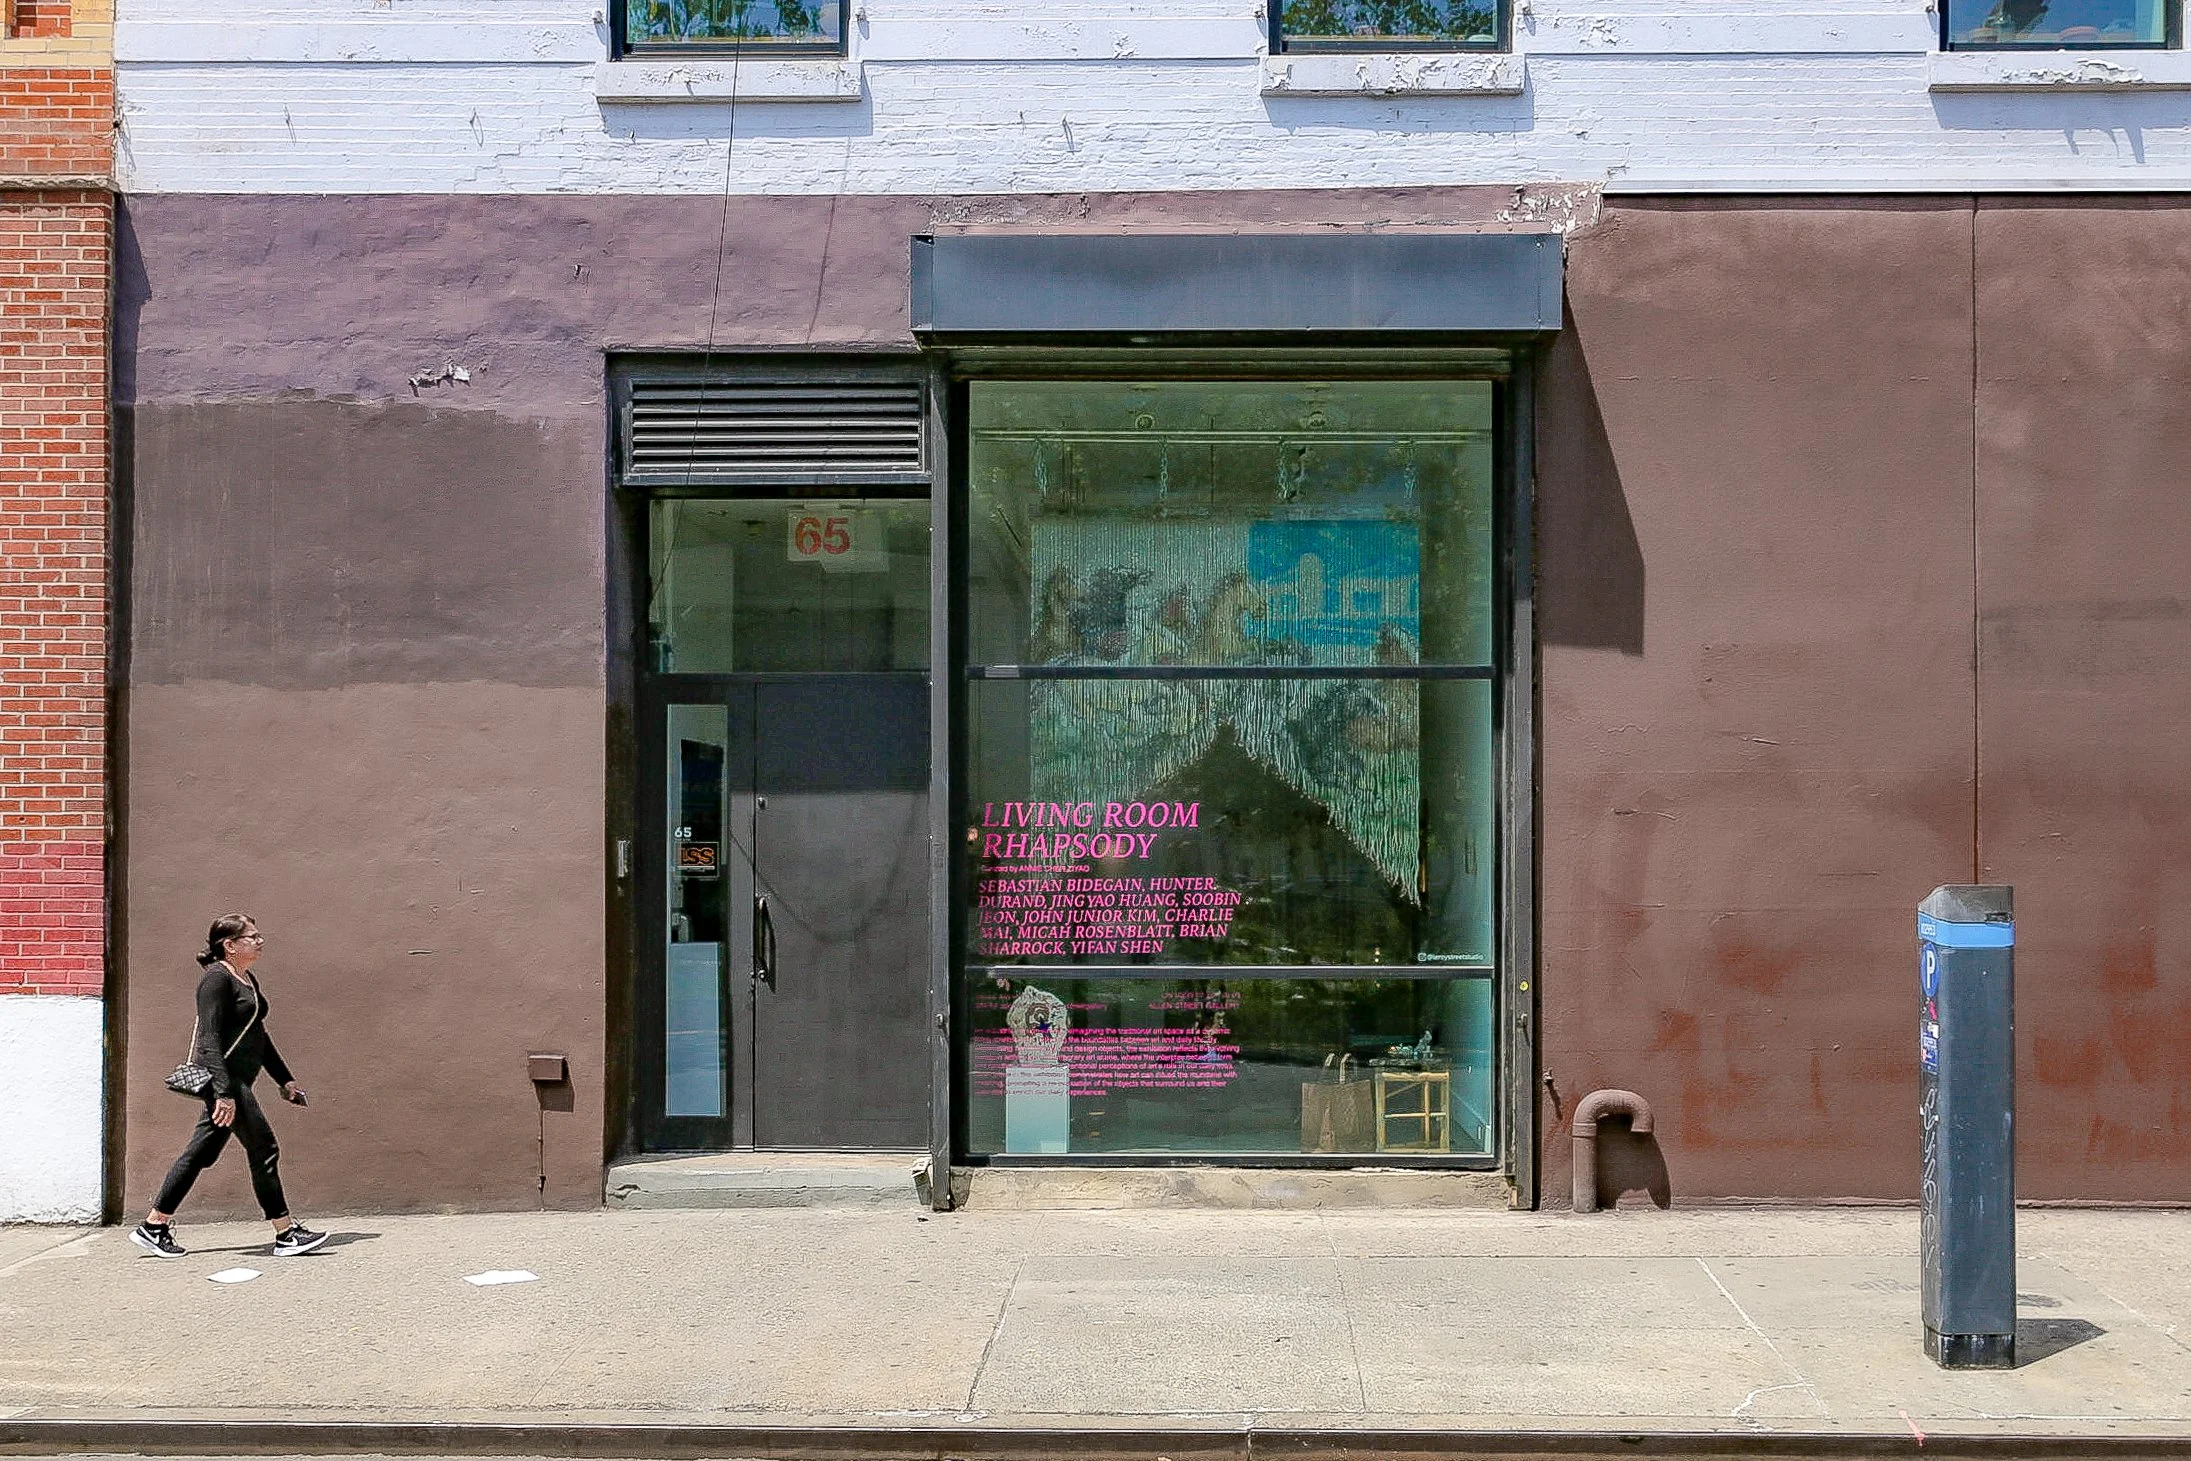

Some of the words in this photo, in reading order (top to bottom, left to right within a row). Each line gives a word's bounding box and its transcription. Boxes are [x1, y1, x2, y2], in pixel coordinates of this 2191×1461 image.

[795, 517, 850, 554] 65
[981, 802, 1093, 828] LIVING
[1103, 802, 1199, 828] ROOM
[674, 826, 692, 838] 65
[982, 833, 1158, 859] RHAPSODY
[979, 879, 1062, 893] SEBASTIAN
[1066, 878, 1145, 892] BIDEGAIN,
[979, 894, 1047, 909] DURAND,
[1119, 893, 1179, 907] HUANG,
[1183, 892, 1242, 906] SOOBIN
[978, 910, 1020, 926] JEON,
[1021, 910, 1064, 926] JOHN
[1064, 910, 1123, 925] JUNIOR
[1127, 909, 1160, 923] KIM,
[1164, 908, 1234, 922] CHARLIE
[1017, 926, 1071, 939] MICAH
[1075, 924, 1175, 938] ROSENBLATT,
[1179, 923, 1228, 937] BRIAN
[1070, 941, 1117, 954] YIFAN
[1120, 940, 1164, 954] SHEN
[1926, 950, 1936, 989] P
